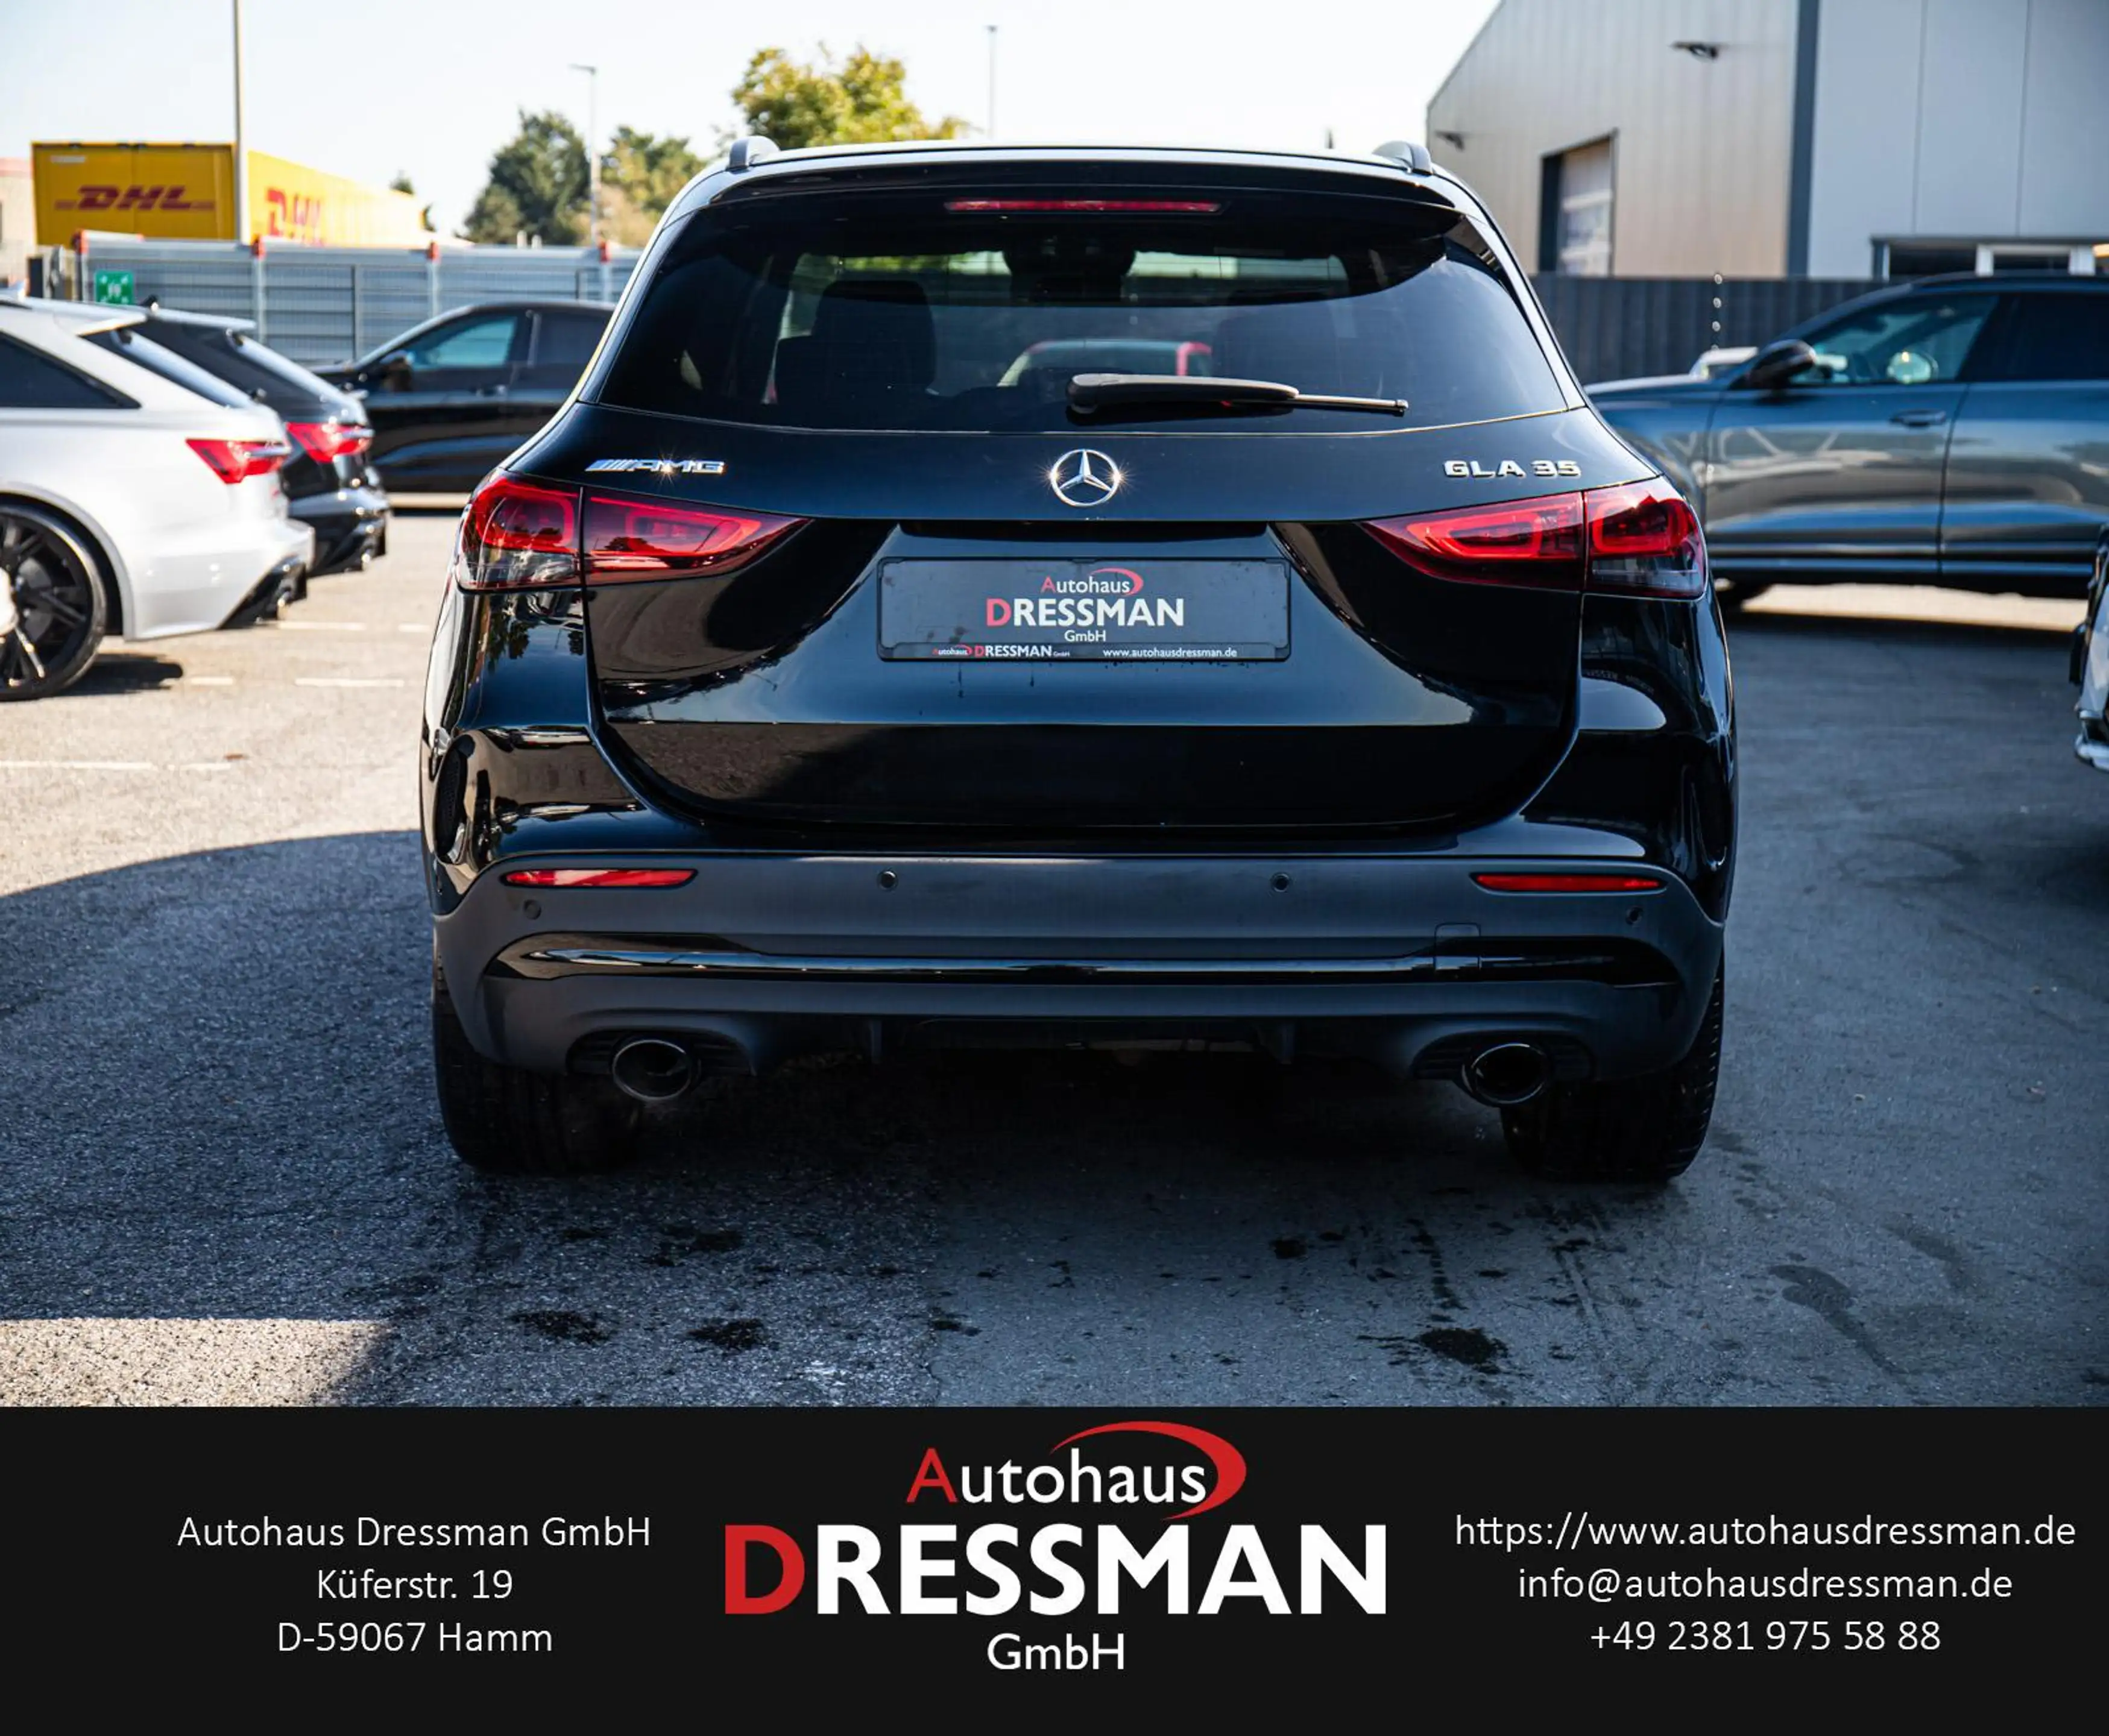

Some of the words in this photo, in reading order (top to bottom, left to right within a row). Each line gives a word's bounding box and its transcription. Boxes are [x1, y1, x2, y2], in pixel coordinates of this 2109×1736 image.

[78, 184, 192, 210] DHL
[628, 458, 725, 474] AMG
[1443, 460, 1527, 478] GLA
[1531, 460, 1581, 478] 35
[1041, 576, 1130, 593] Autohaus
[986, 598, 1185, 627] DRESSMAN
[1064, 629, 1106, 642] GmbH
[974, 646, 1052, 656] DRESSMAN
[1103, 647, 1237, 657] www.autohausdressman.de
